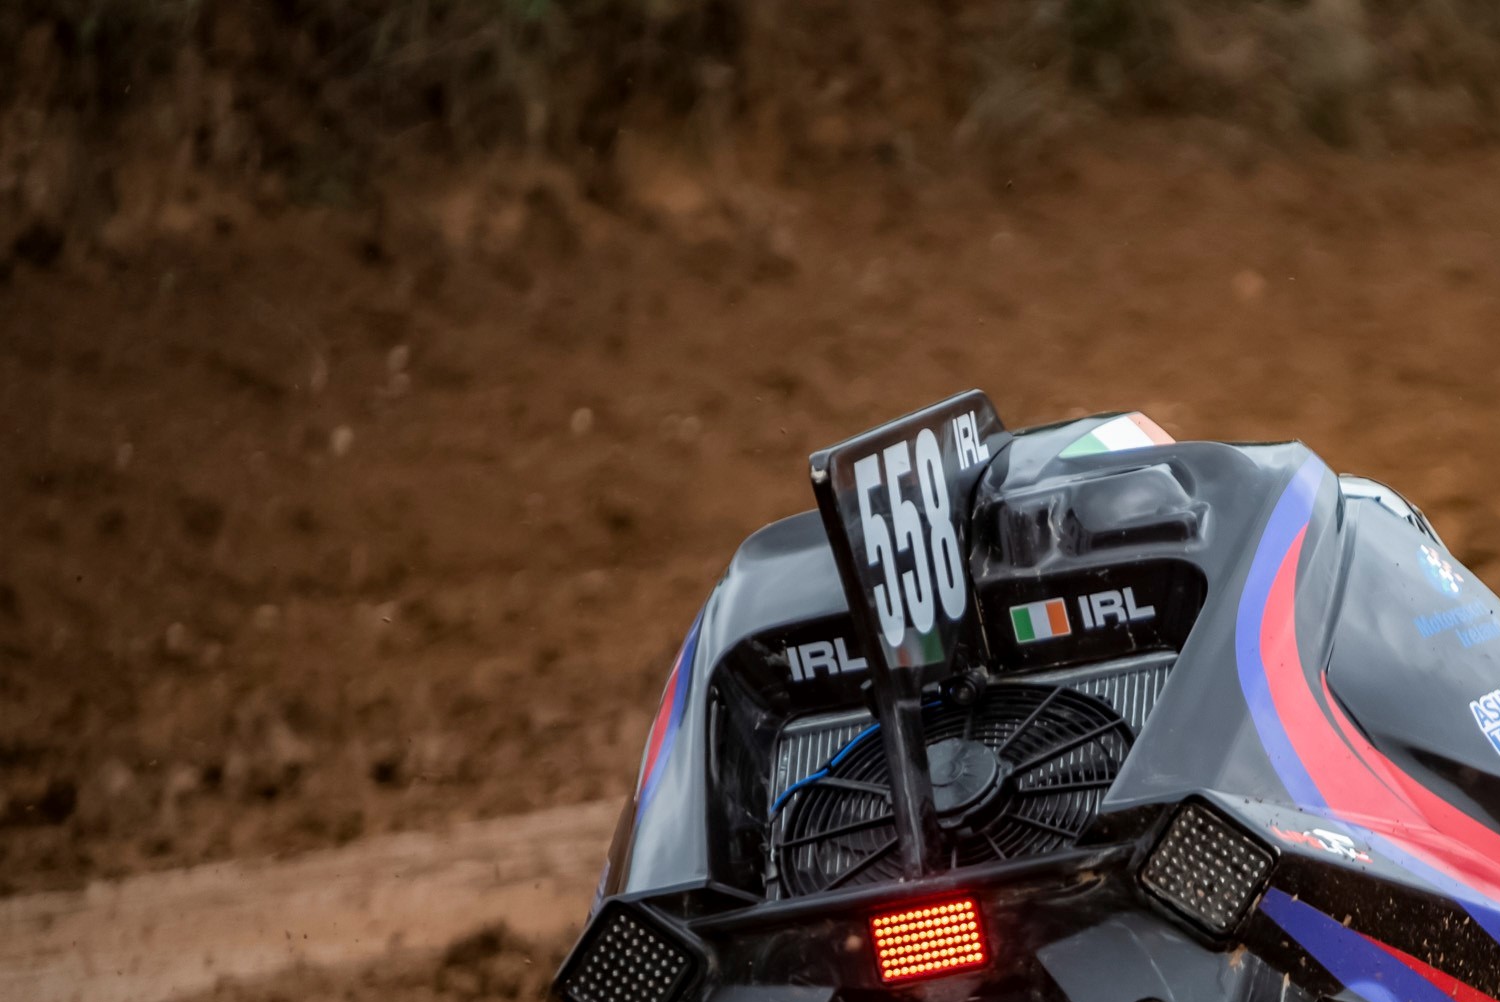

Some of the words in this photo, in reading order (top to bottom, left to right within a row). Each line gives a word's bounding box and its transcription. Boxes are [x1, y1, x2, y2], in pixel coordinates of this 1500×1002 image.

[952, 410, 989, 470] IRL
[854, 428, 967, 648] 558
[1078, 586, 1156, 629] IRL
[786, 637, 868, 682] IRL
